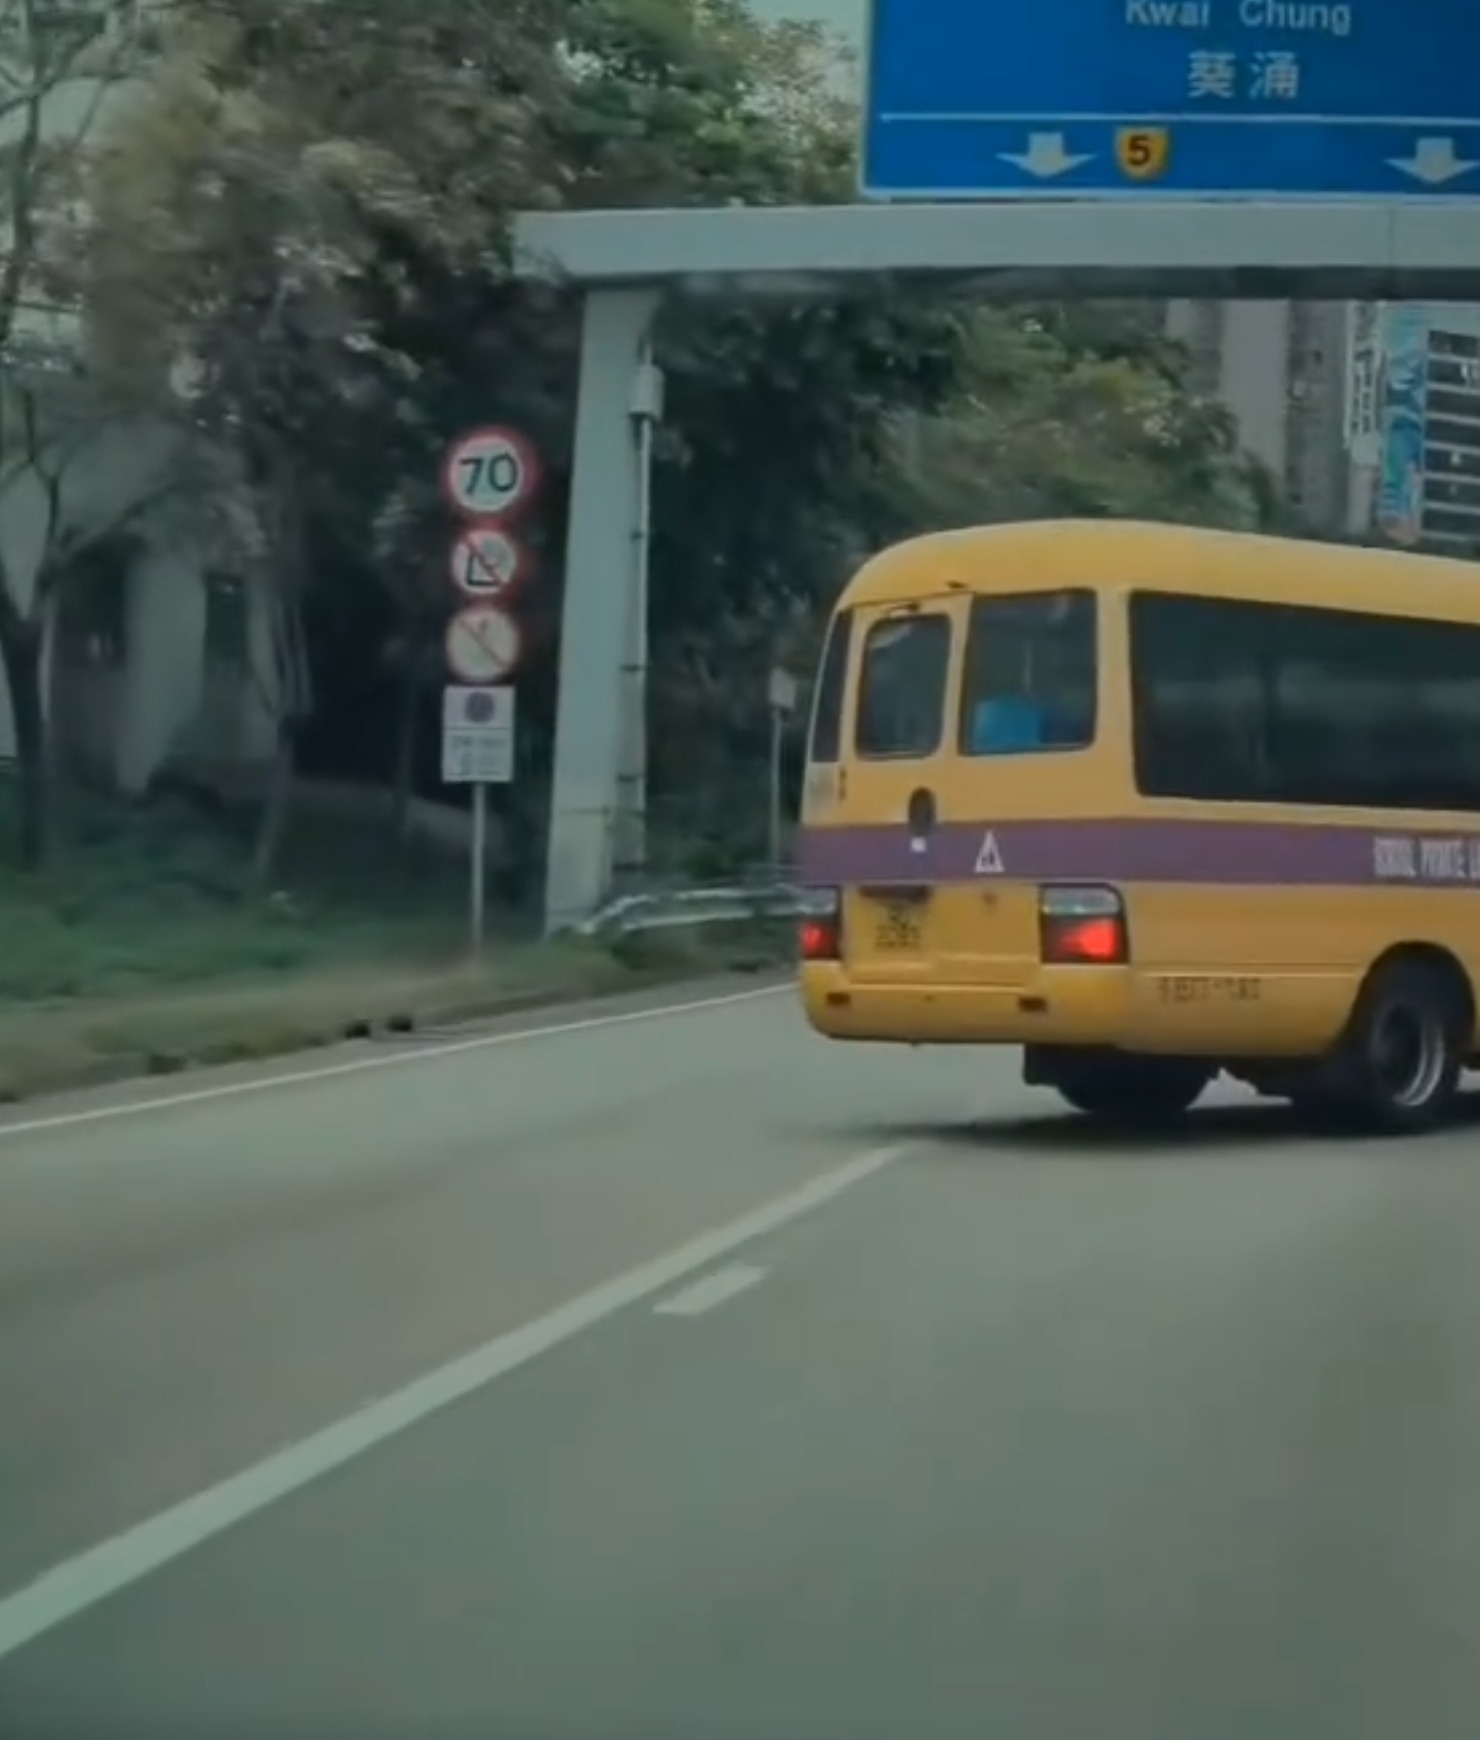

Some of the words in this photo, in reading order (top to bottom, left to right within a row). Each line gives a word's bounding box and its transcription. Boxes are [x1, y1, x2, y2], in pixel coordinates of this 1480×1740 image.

[1126, 0, 1209, 27] Kwai
[1239, 0, 1352, 37] Chung
[1187, 49, 1300, 99] 葵涌
[1127, 134, 1151, 166] 5
[459, 452, 518, 496] 70
